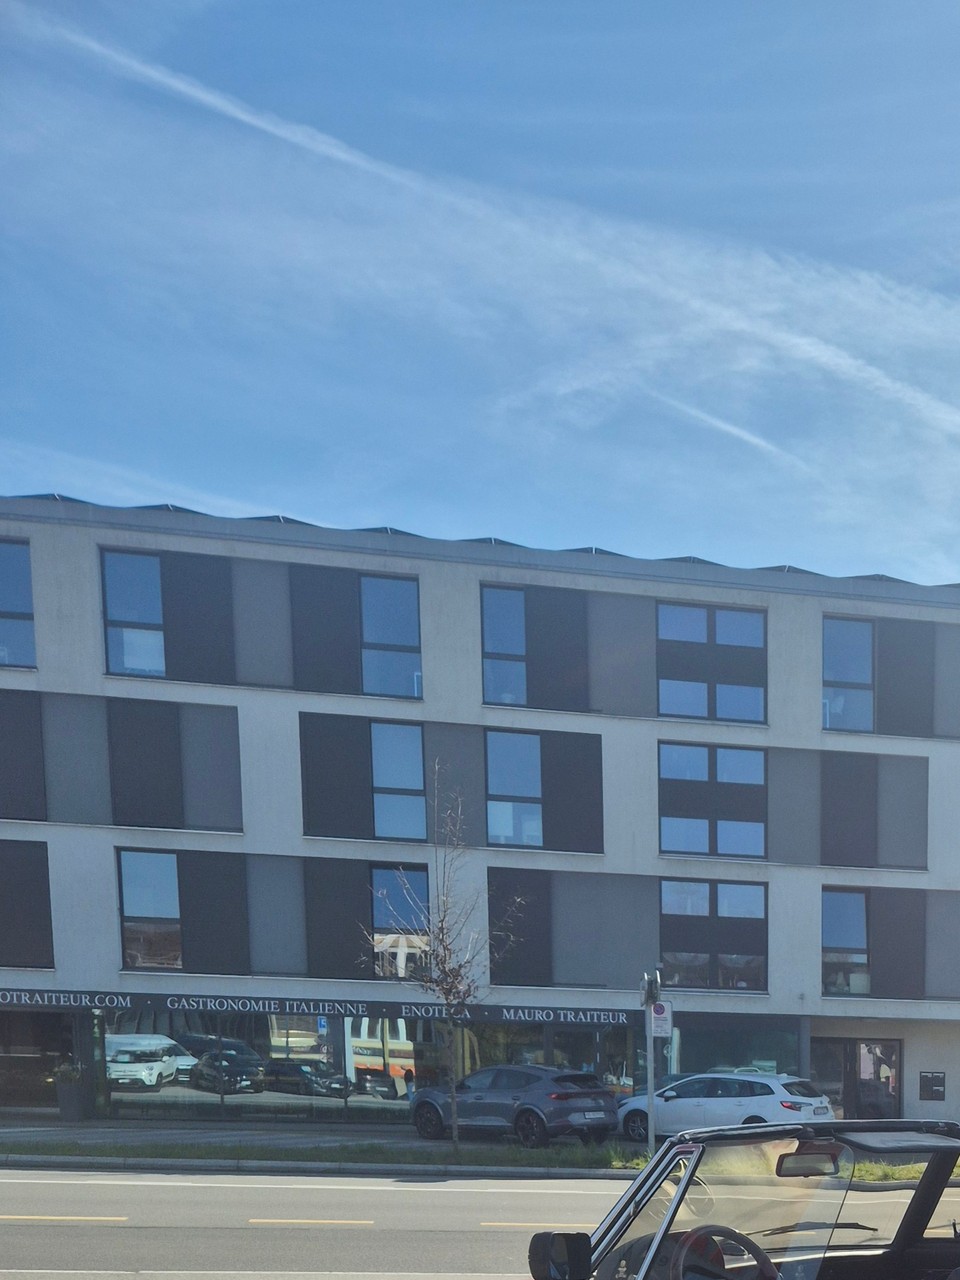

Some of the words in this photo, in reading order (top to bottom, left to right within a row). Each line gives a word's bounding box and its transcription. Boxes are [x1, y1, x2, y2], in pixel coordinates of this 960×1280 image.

[0, 991, 132, 1008] OTRAITEUR.COM
[166, 996, 281, 1013] GASTRONOMIE
[285, 1001, 368, 1015] ITALIENNE
[502, 1008, 554, 1022] MAURO
[557, 1010, 628, 1024] TRAITEUR
